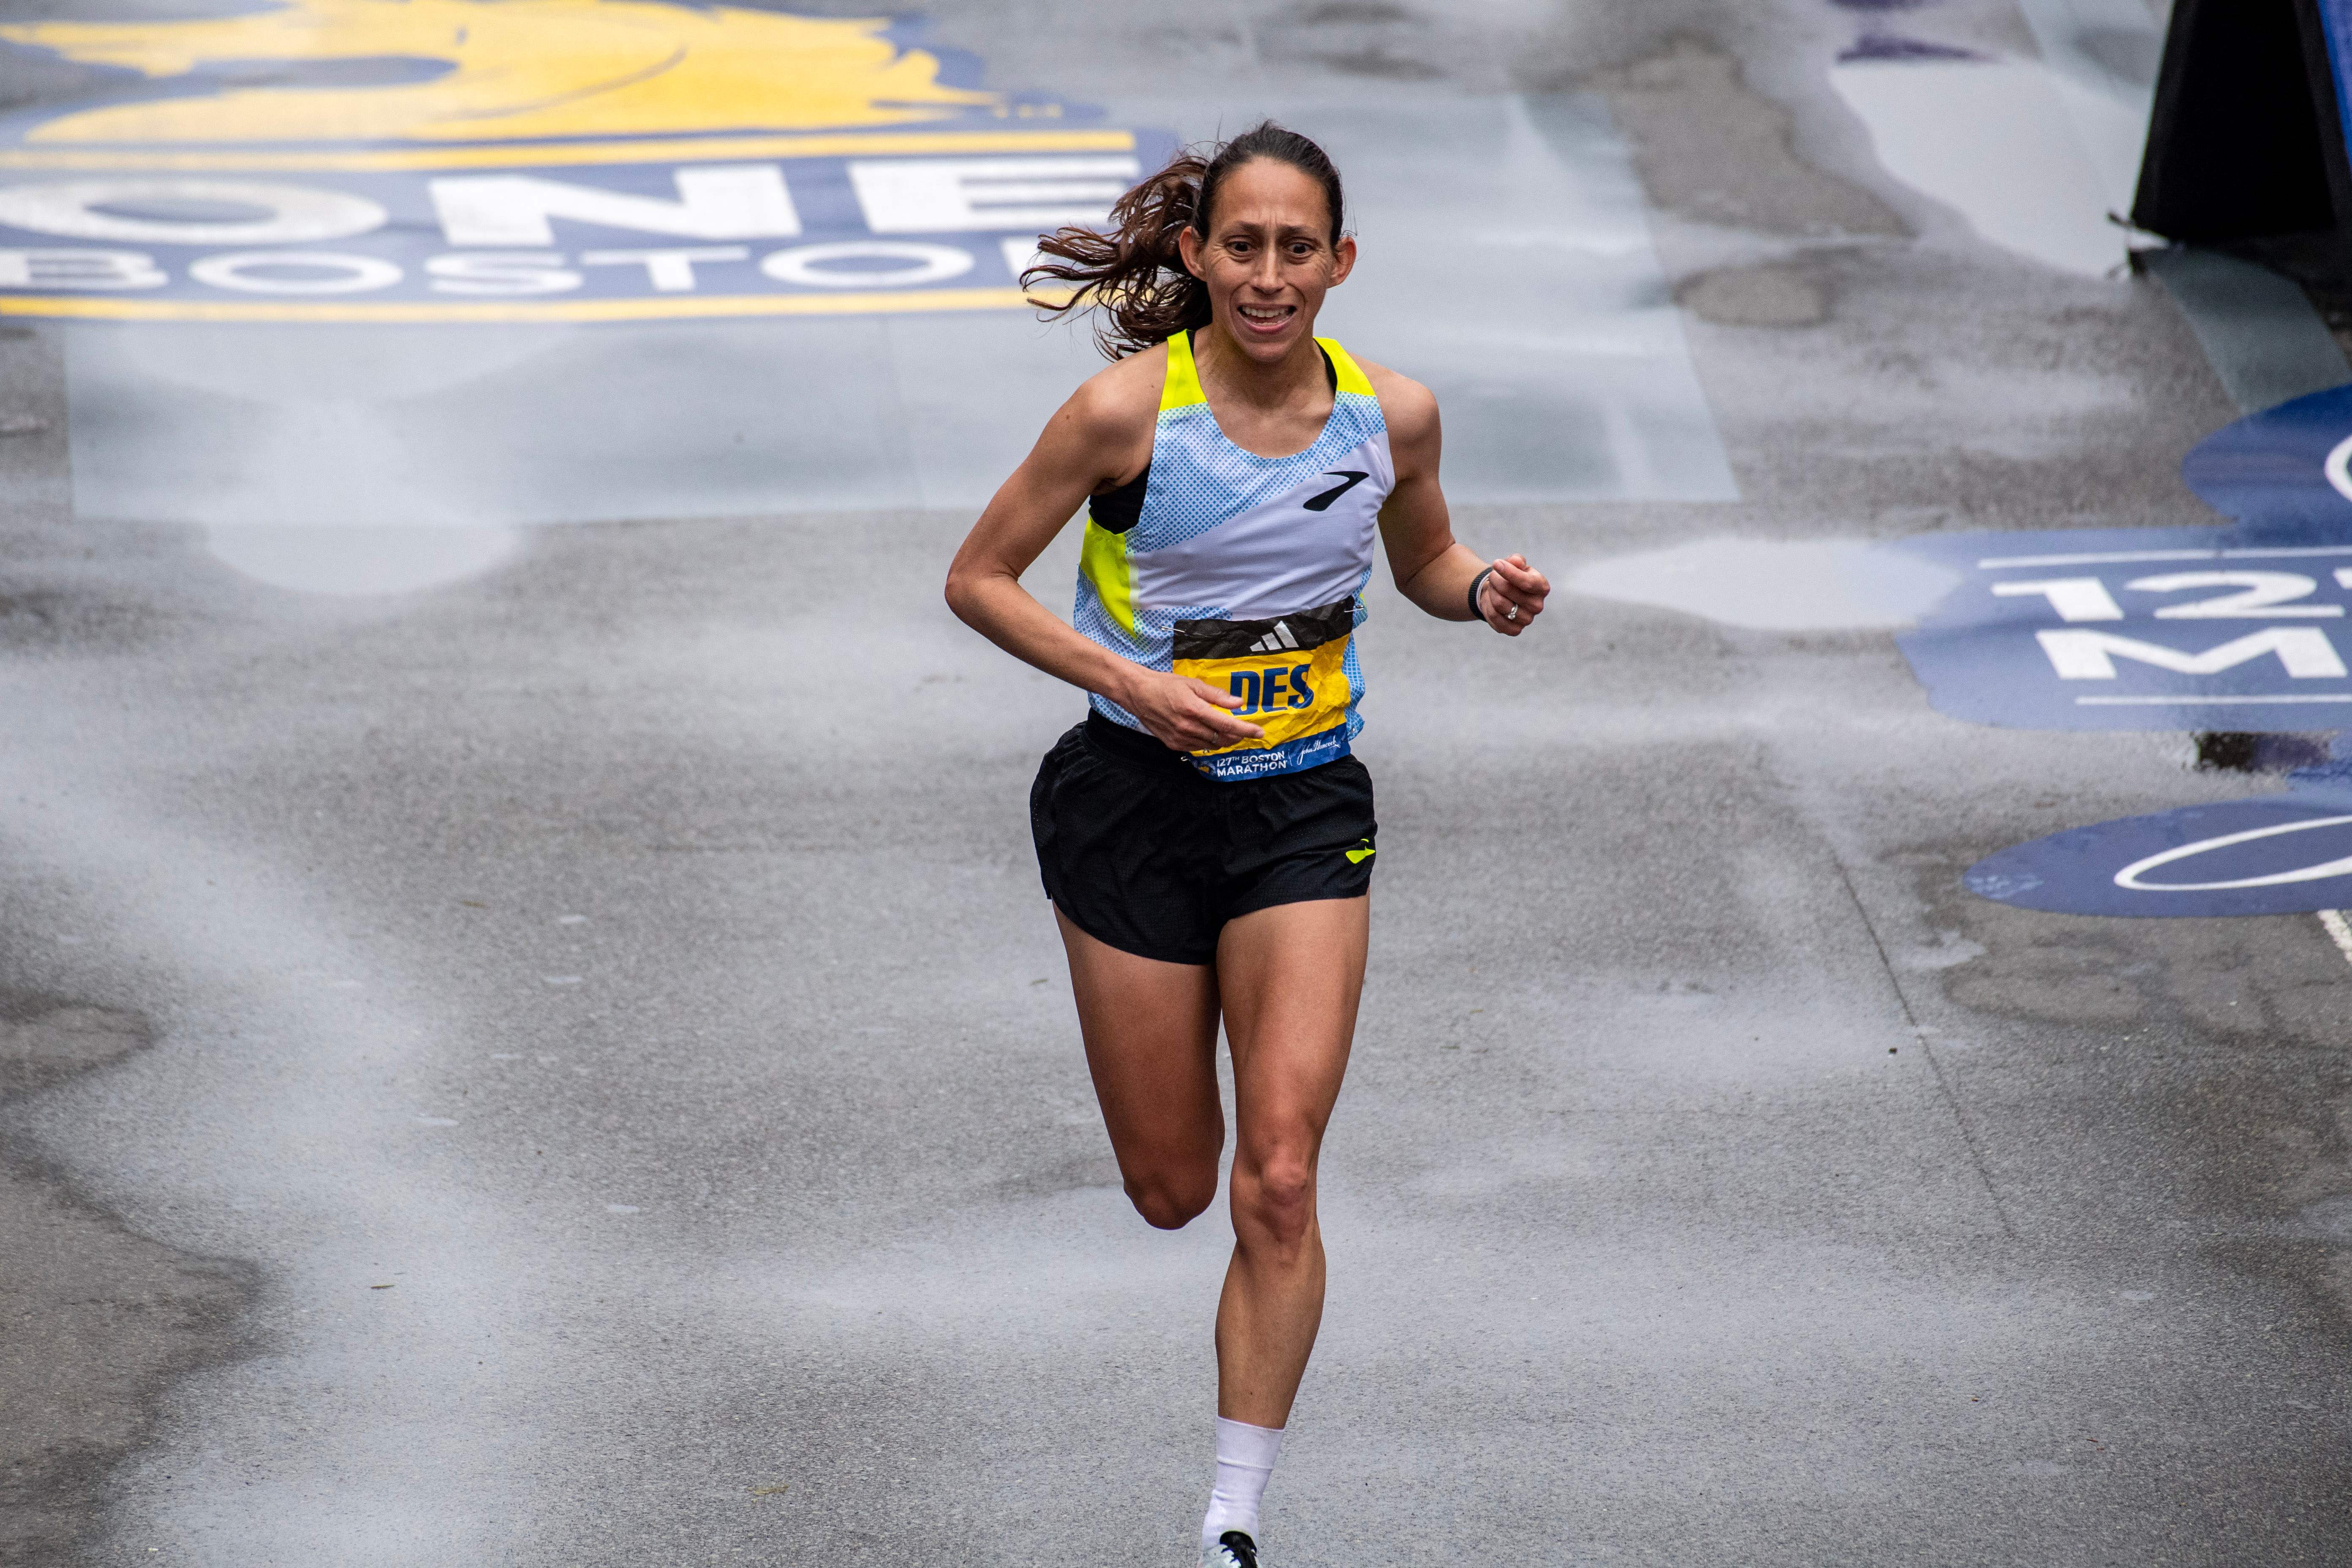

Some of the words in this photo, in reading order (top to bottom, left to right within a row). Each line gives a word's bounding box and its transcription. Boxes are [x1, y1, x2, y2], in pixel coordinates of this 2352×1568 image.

[0, 155, 1140, 244] ONE
[1990, 566, 2352, 623] 12
[1230, 663, 1314, 716] DES
[1217, 760, 1287, 777] MARATHON
[1241, 750, 1285, 764] BOSTON
[1297, 743, 1312, 765] John
[1313, 735, 1341, 751] Hancock
